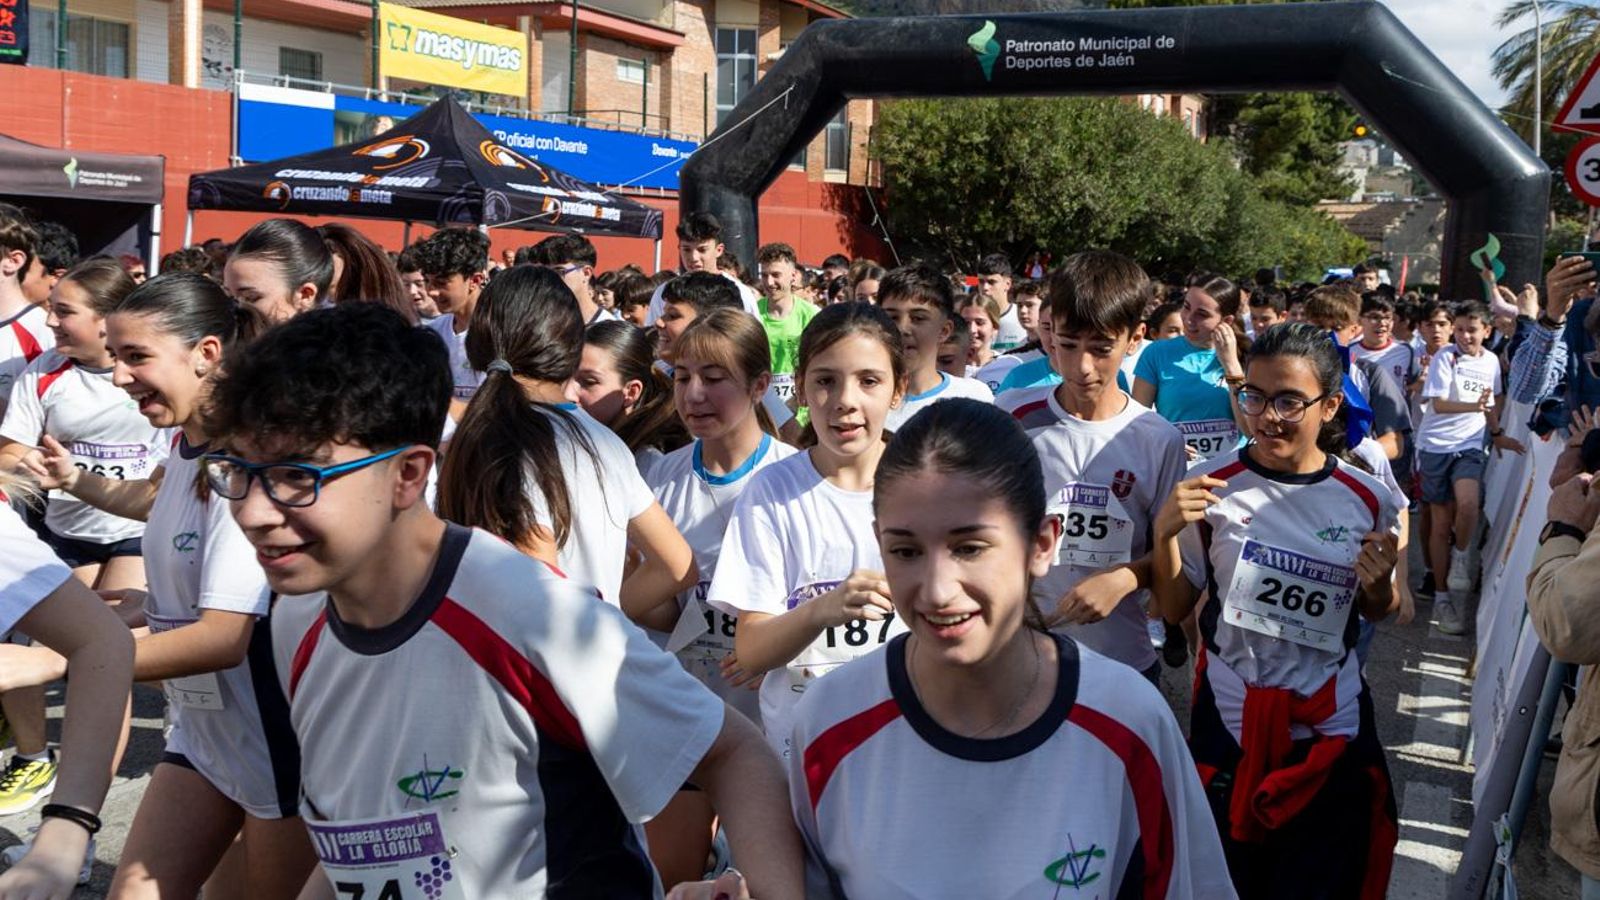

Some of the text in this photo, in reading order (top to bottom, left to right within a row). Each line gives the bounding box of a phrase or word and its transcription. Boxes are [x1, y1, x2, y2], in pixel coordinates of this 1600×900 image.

[415, 28, 521, 71] masymas
[1005, 35, 1175, 53] Patronato Municipal de
[1005, 52, 1135, 71] Deportes de Jaén
[507, 132, 535, 149] oficial
[536, 137, 553, 150] con
[554, 137, 588, 155] Davante
[1187, 436, 1224, 453] 597
[1256, 577, 1328, 617] 266
[826, 612, 895, 648] 187
[338, 830, 383, 846] CARRERA
[383, 821, 433, 842] ESCOLAR
[348, 838, 422, 860] LA GLORIA
